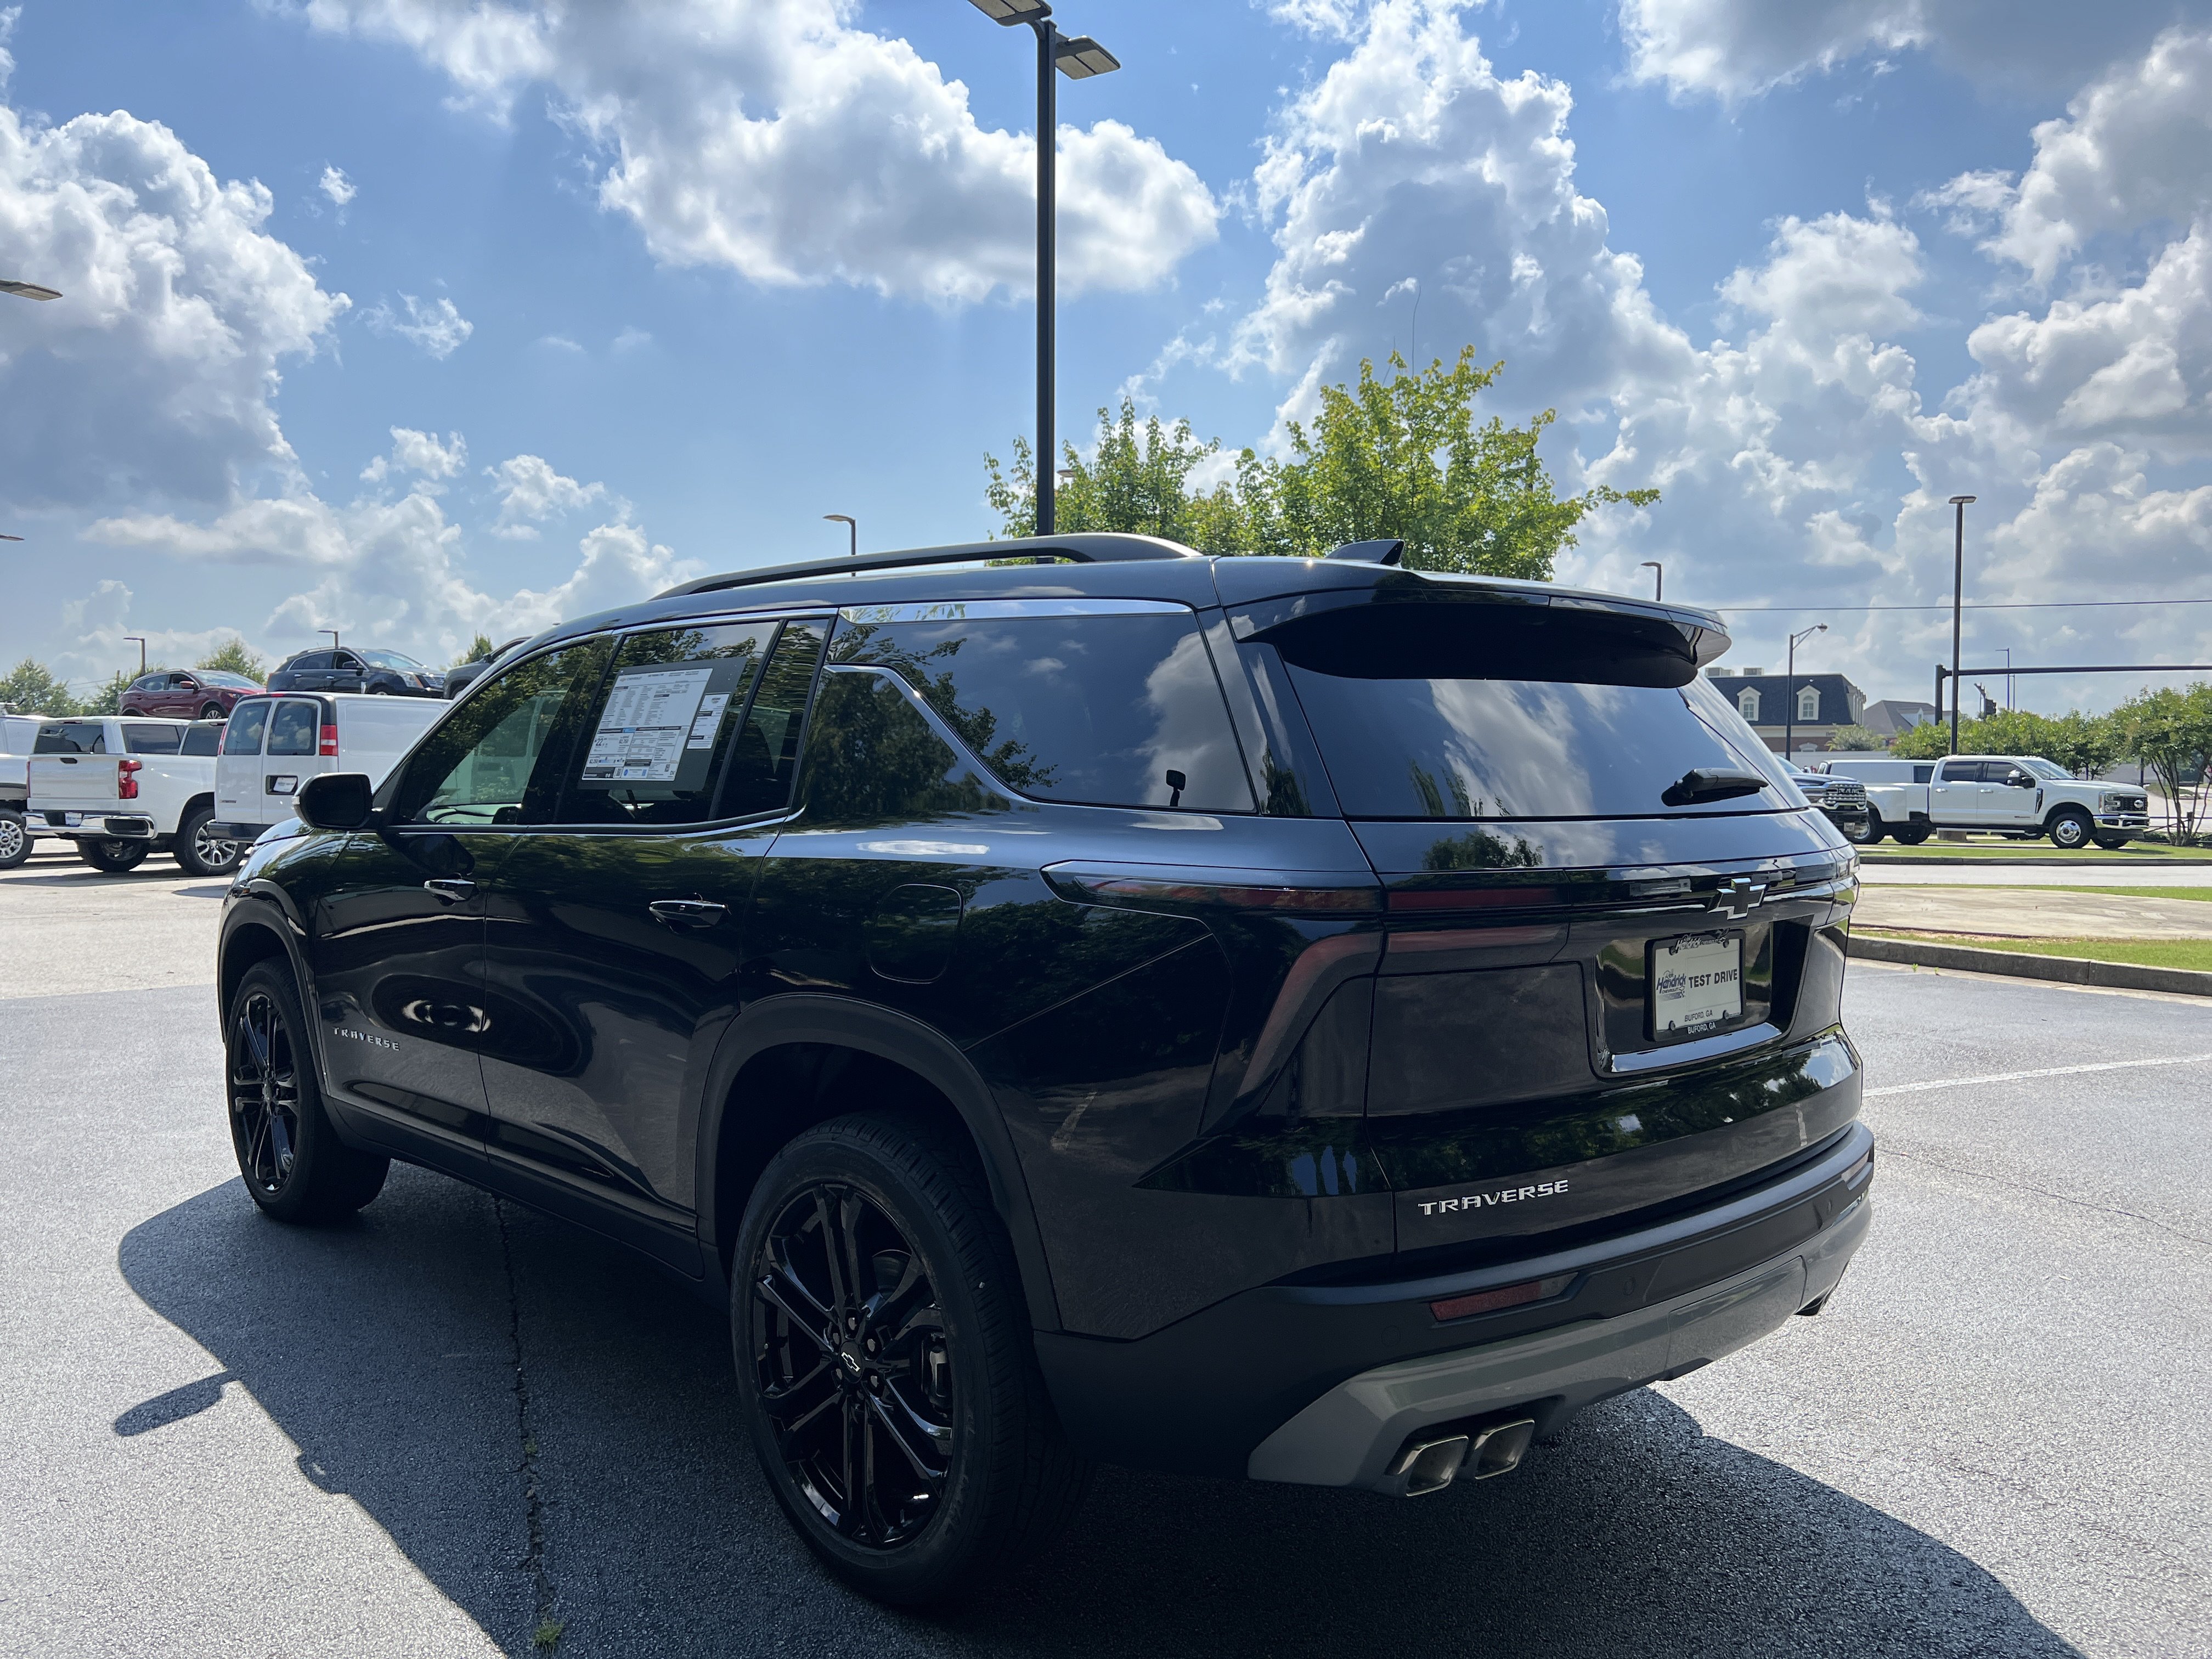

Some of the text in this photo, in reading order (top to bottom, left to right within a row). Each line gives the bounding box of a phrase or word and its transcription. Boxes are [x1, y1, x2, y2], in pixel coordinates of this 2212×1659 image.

[1656, 973, 1686, 994] Hendrick
[1689, 968, 1737, 989] TEST DRIVE
[332, 1027, 399, 1051] TRAVERSE
[1418, 1180, 1568, 1216] TRAVERSE
